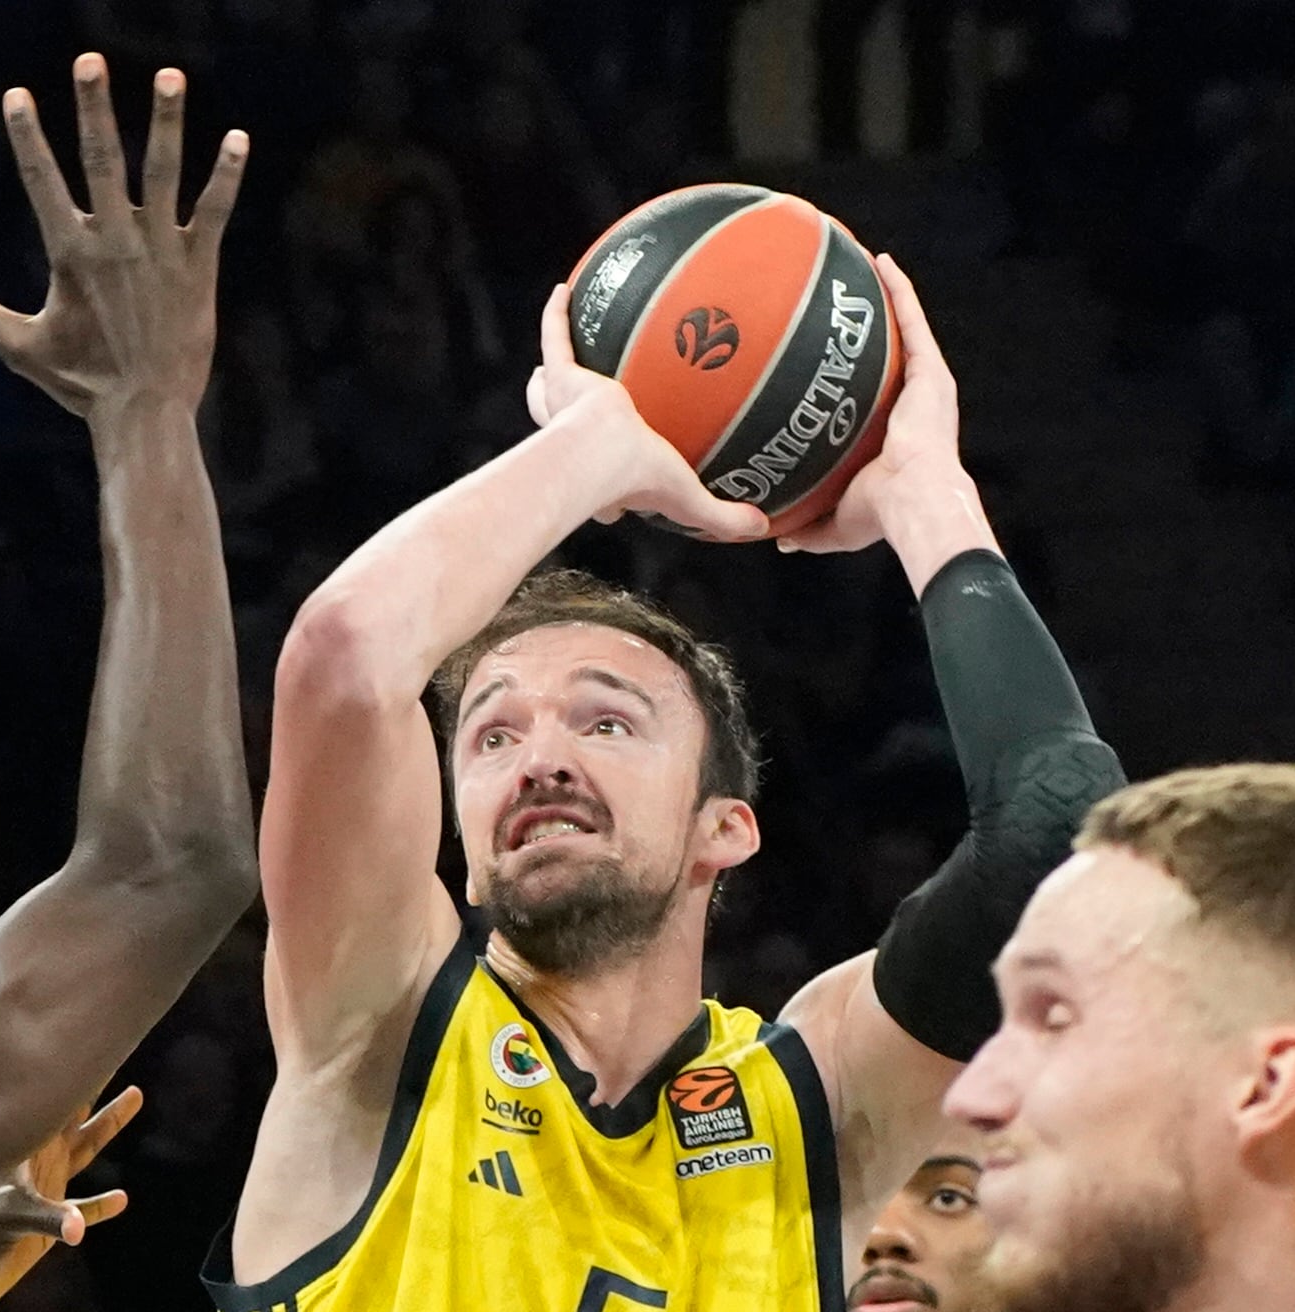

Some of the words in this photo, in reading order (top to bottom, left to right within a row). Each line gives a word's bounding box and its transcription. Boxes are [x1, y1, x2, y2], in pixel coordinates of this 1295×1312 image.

[711, 278, 876, 502] SPALDING
[484, 1087, 543, 1127] beko
[680, 1106, 743, 1127] TURKISH
[684, 1117, 746, 1137] AIRLINES
[676, 1146, 772, 1177] oneteam
